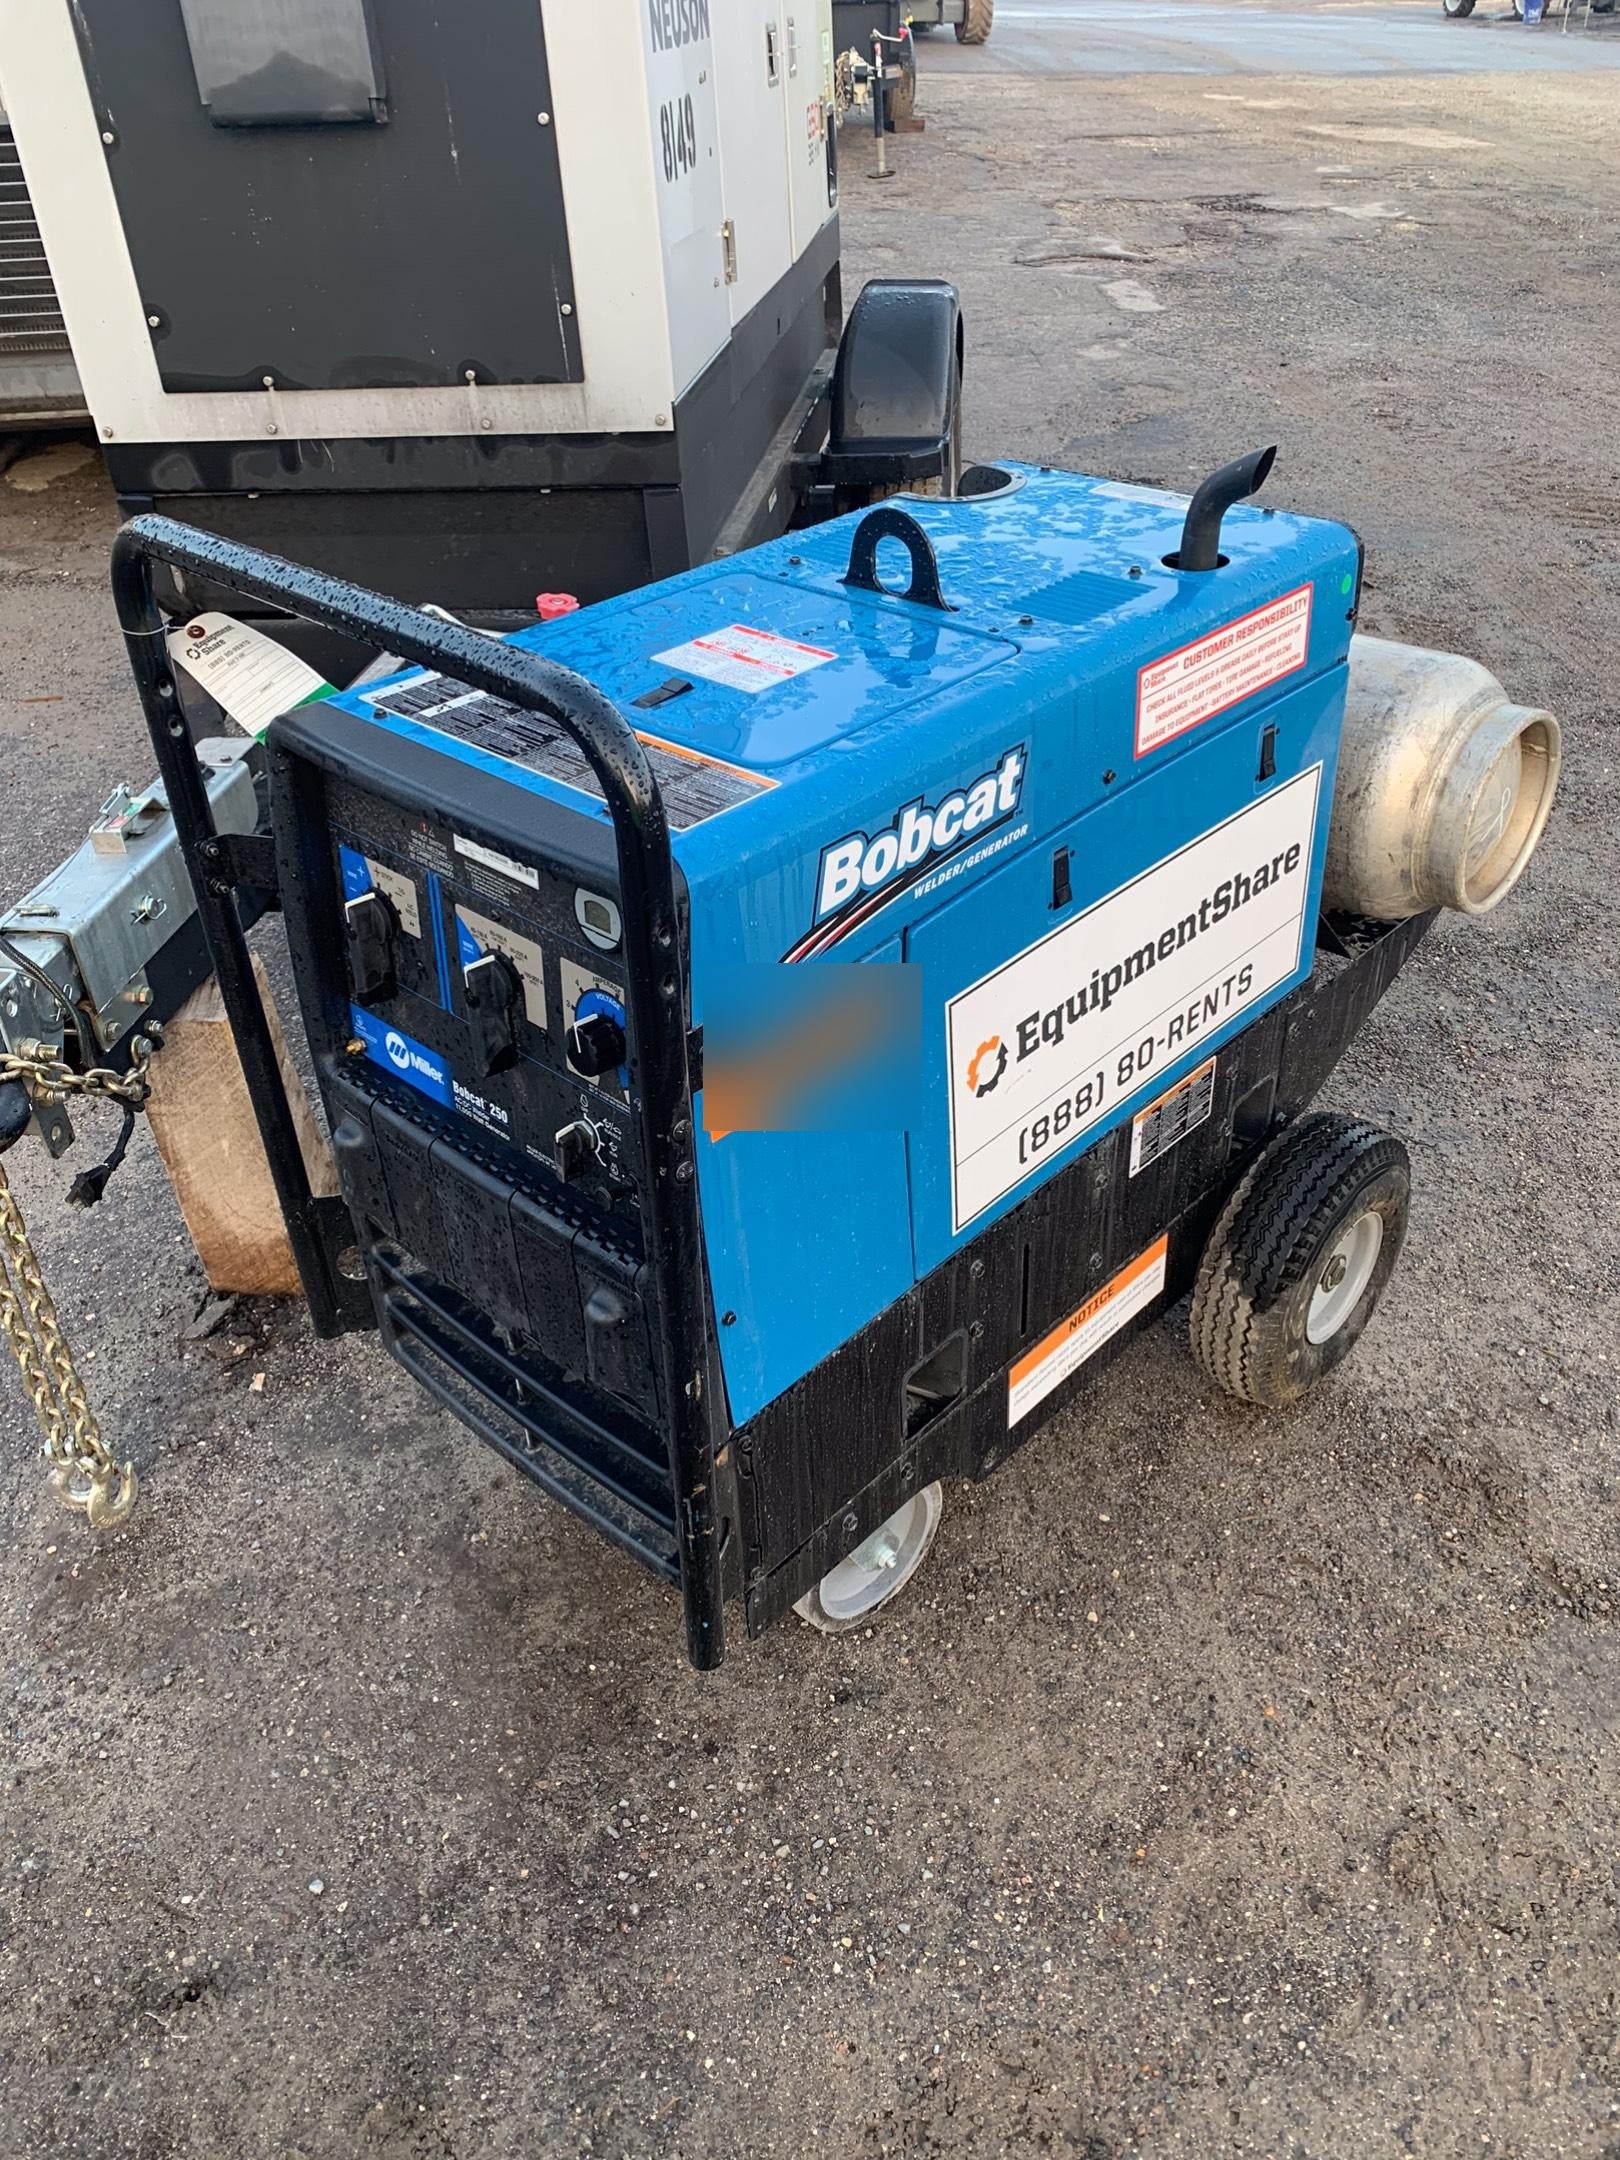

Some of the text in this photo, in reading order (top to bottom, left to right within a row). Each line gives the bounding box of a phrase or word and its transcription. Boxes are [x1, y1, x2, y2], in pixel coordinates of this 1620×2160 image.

[649, 0, 710, 52] NEUSON
[660, 92, 697, 183] 8149
[192, 624, 235, 649] Equipment
[201, 639, 226, 655] Share
[1183, 597, 1307, 670] CUSTOMER RESPONSIBILITY
[818, 753, 1023, 915] Bobcat
[912, 824, 1028, 899] WELDER/GENERATOR
[1017, 842, 1301, 1062] EquipmentShare
[595, 993, 622, 1010] VOLTAGE
[409, 1052, 443, 1084] Miller
[1019, 1072, 1104, 1164] (888)
[1116, 964, 1253, 1088] 80-RENTS
[452, 1080, 508, 1124] Bobcat 250
[1069, 1284, 1115, 1332] NOTICE
